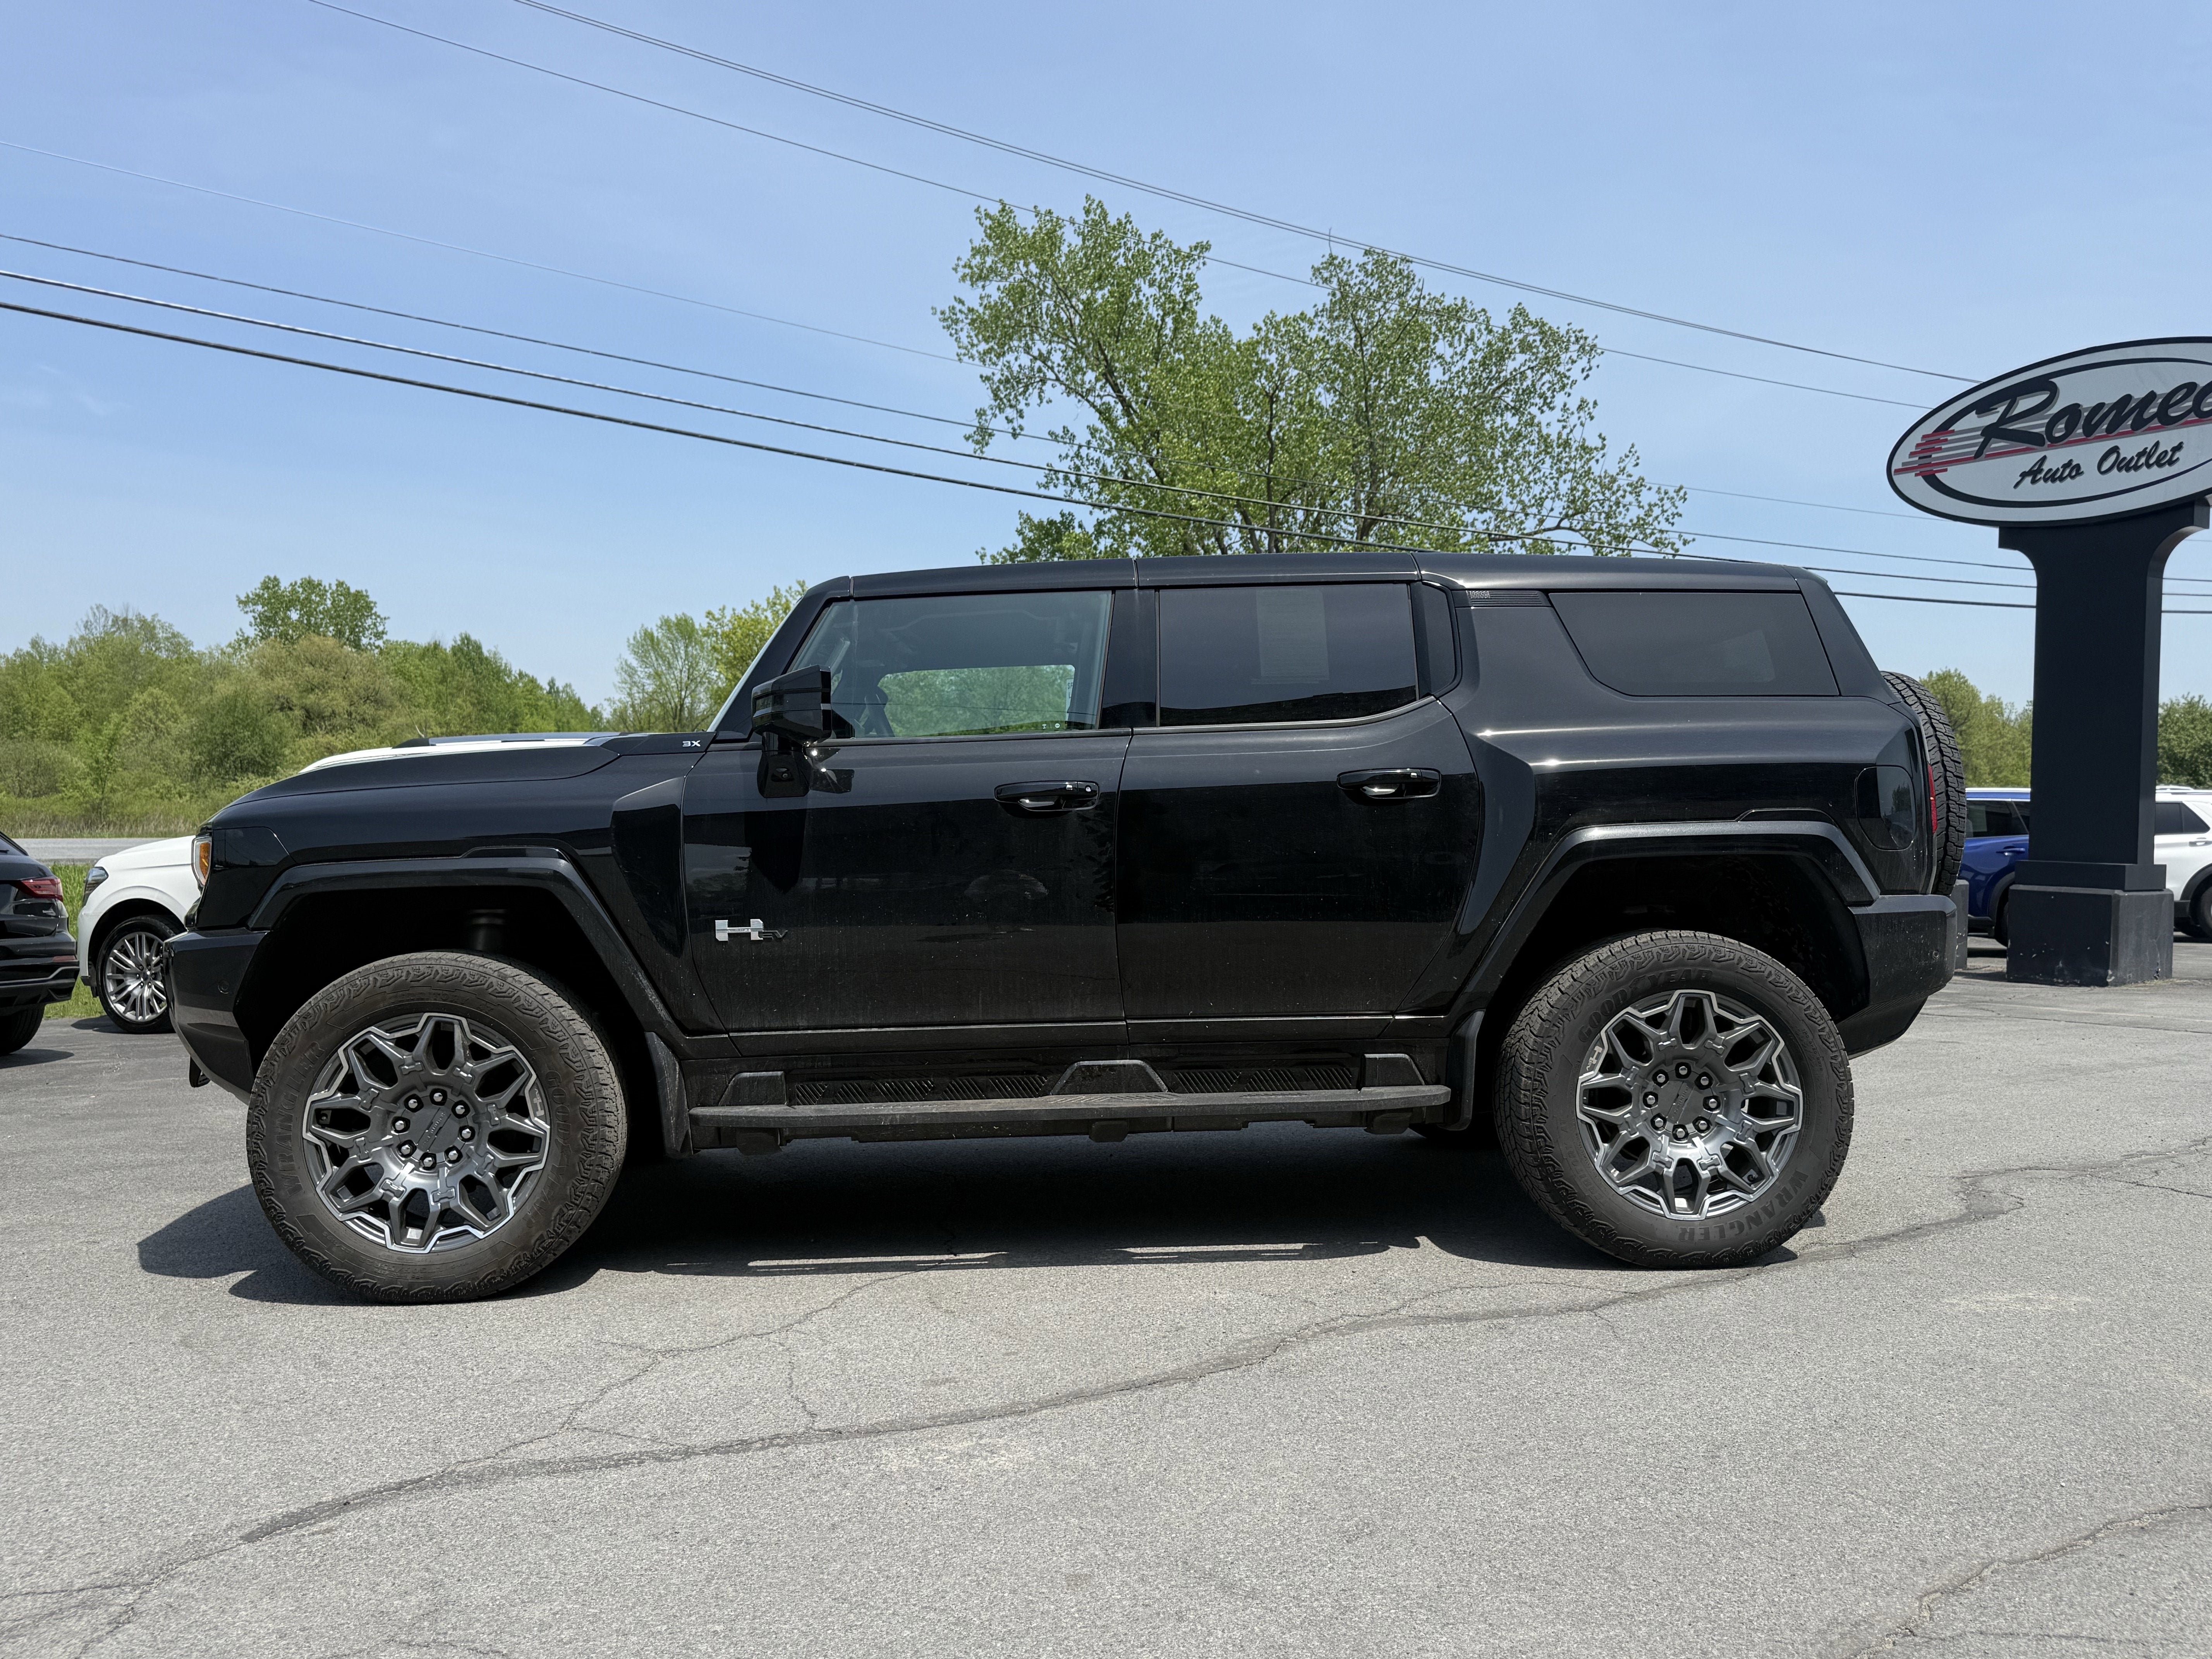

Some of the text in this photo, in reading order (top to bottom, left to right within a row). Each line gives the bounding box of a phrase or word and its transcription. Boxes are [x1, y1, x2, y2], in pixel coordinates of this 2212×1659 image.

[2013, 440, 2184, 489] Auto Outlet
[274, 1040, 326, 1198] WRANGLER
[1679, 1168, 1809, 1244] WRANGLER
